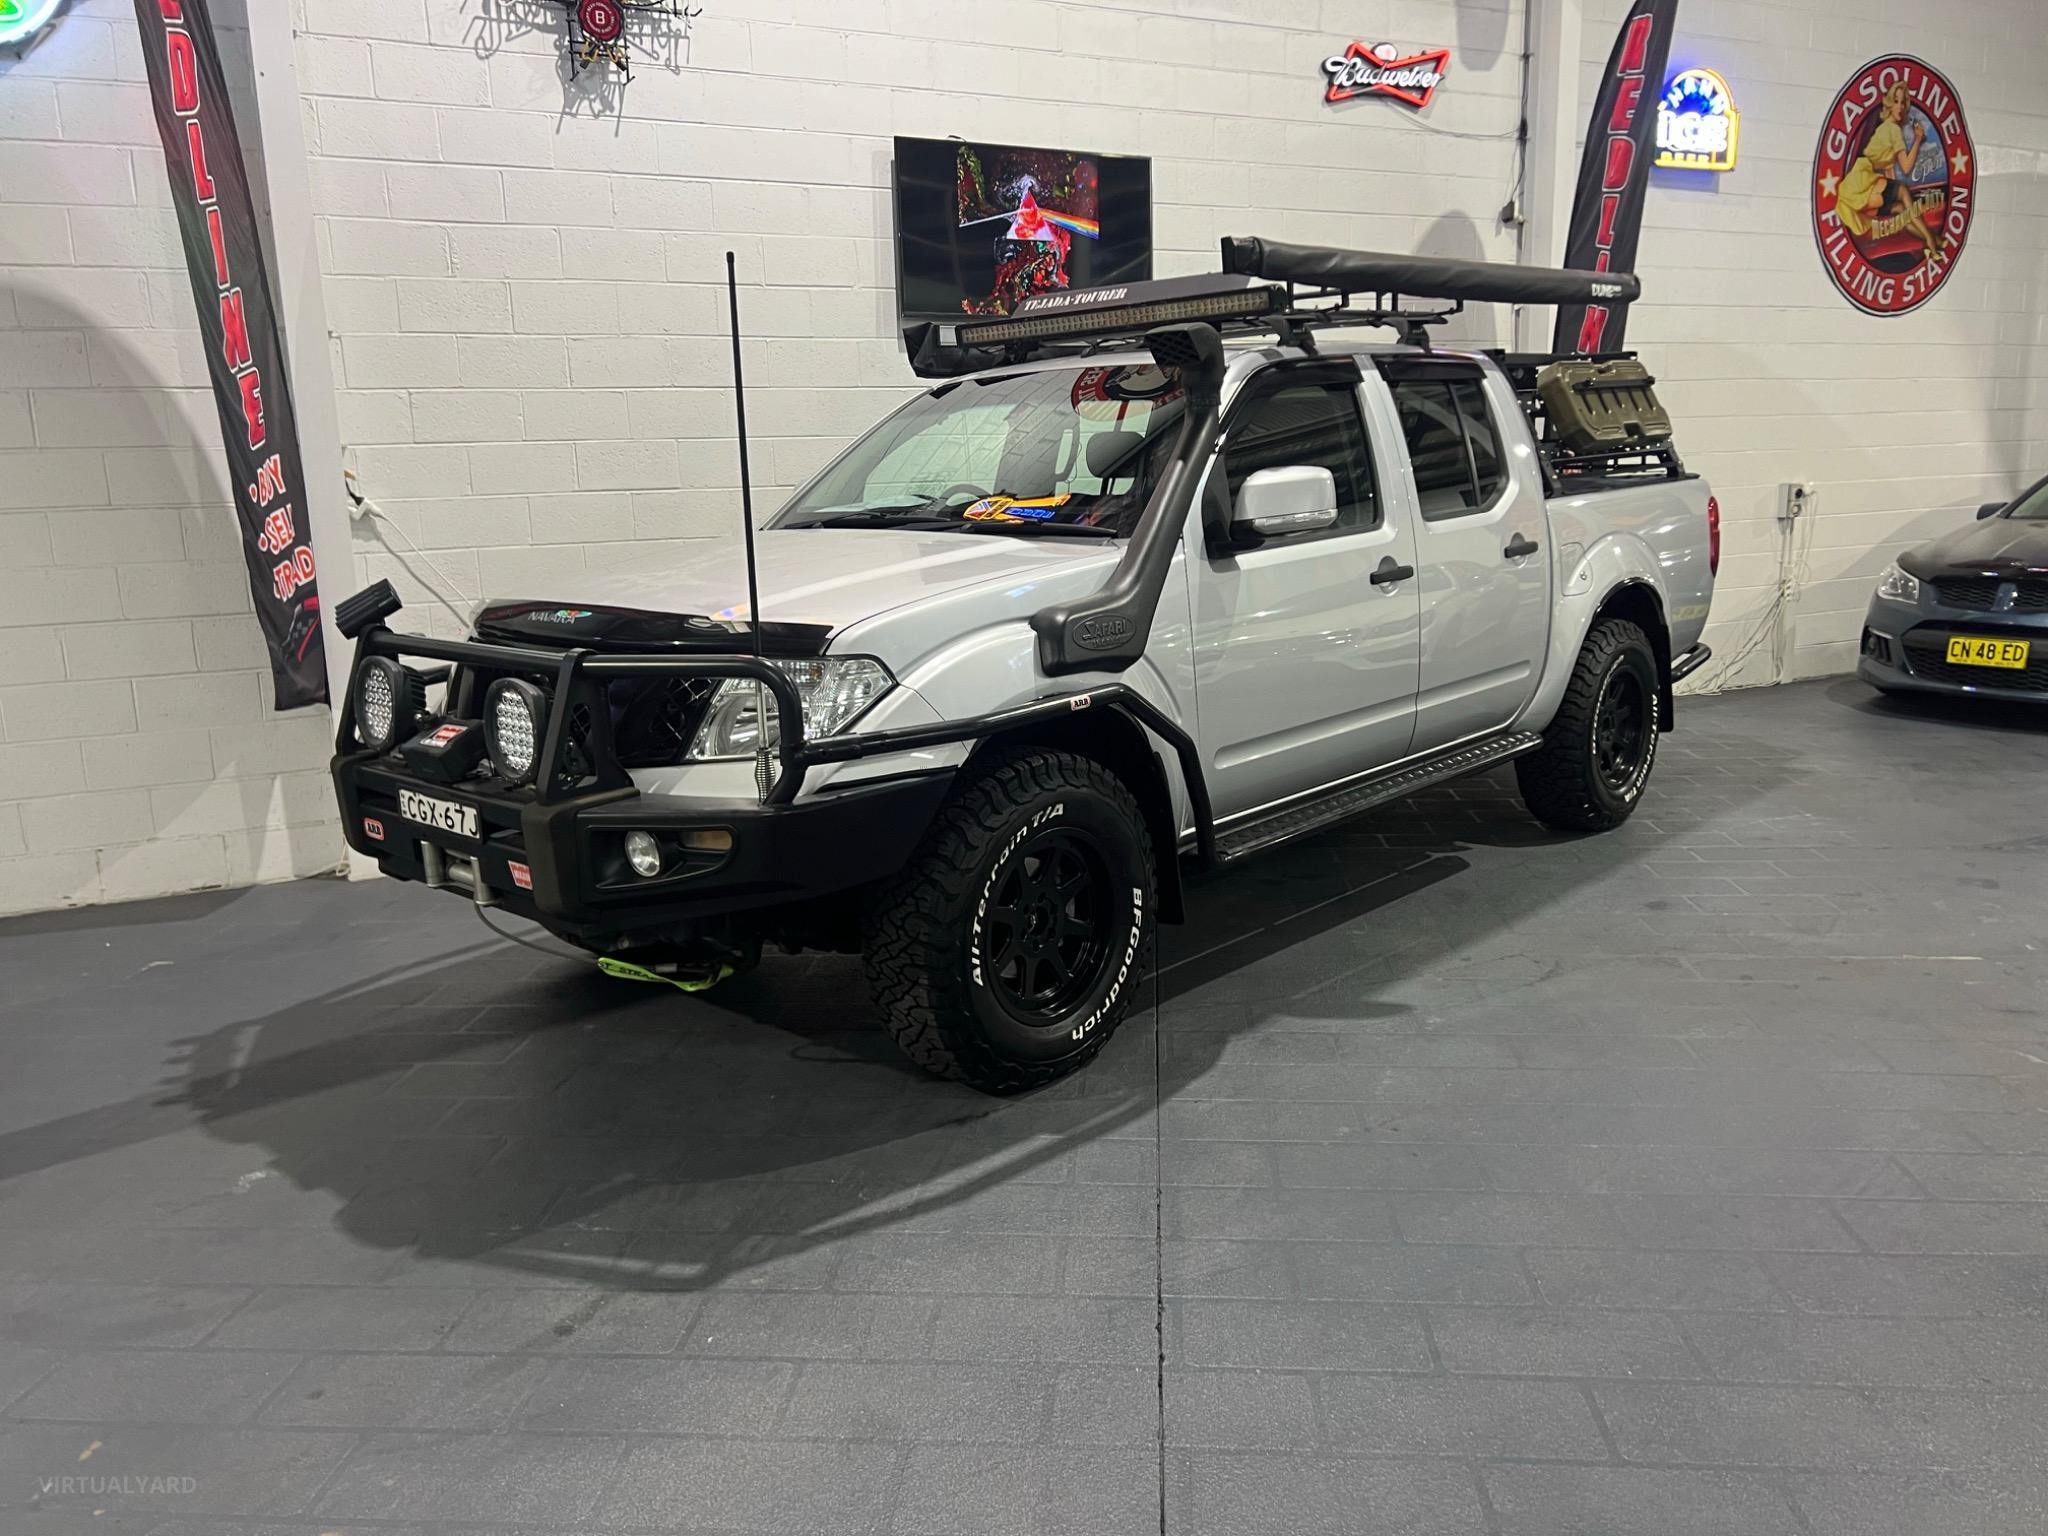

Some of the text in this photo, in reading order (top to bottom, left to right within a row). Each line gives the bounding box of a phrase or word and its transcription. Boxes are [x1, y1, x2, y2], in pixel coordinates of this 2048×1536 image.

[1325, 56, 1442, 88] Budweiser
[1827, 67, 1961, 161] GASOLINE
[1820, 186, 1969, 305] FILLING STATION
[1082, 619, 1126, 640] SAFARI
[1976, 643, 1996, 660] 48
[2002, 644, 2025, 662] ED
[971, 802, 1065, 987] All-Terrain T/A
[1072, 887, 1143, 1041] BFGoodrich
